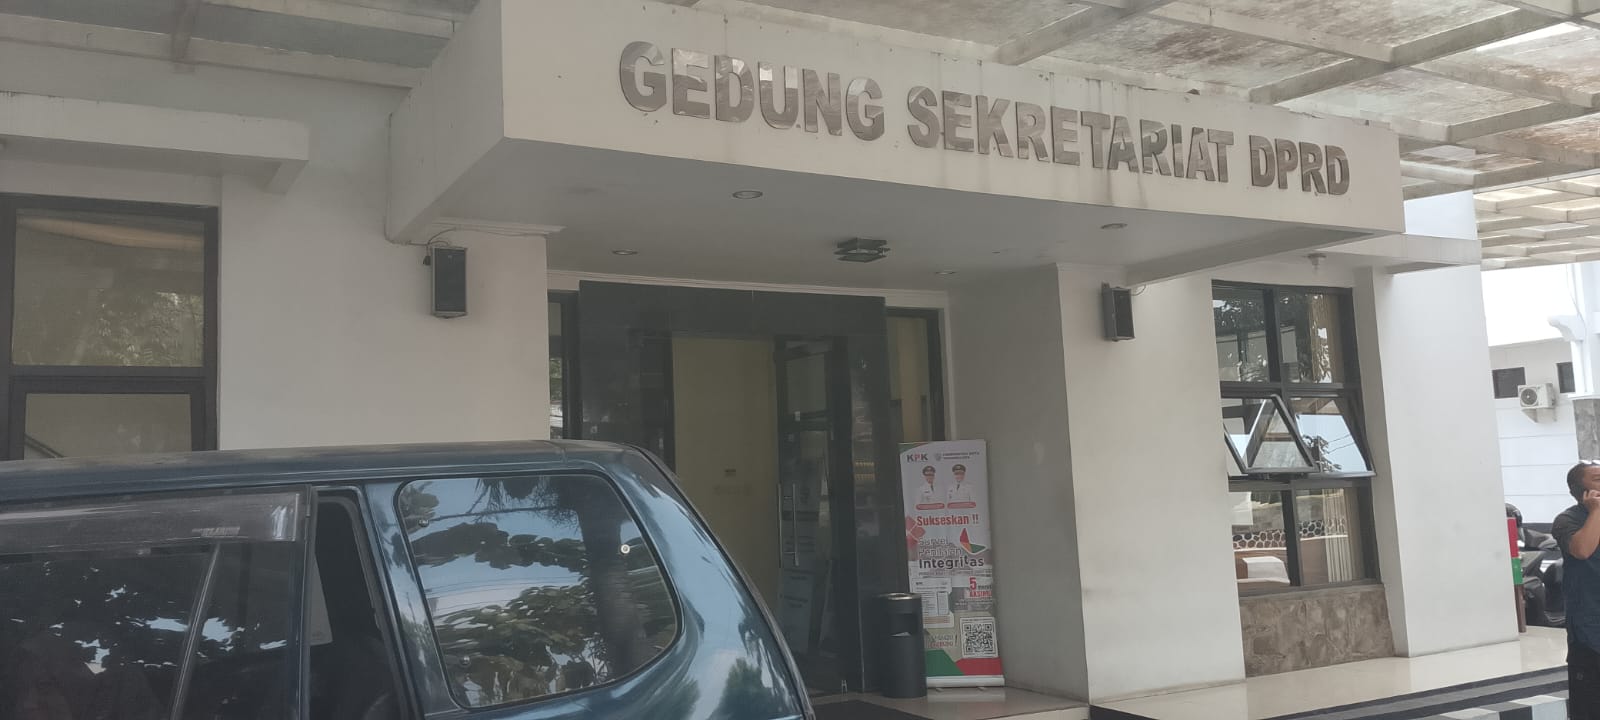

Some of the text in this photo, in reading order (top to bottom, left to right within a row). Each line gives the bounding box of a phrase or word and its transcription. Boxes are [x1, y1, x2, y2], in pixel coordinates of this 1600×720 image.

[619, 41, 1350, 196] GEDUNG SEKRETARIAT DPRD
[907, 453, 928, 463] KPK
[916, 514, 969, 527] Sukseskan
[919, 555, 985, 570] Integritas
[969, 577, 976, 590] 5
